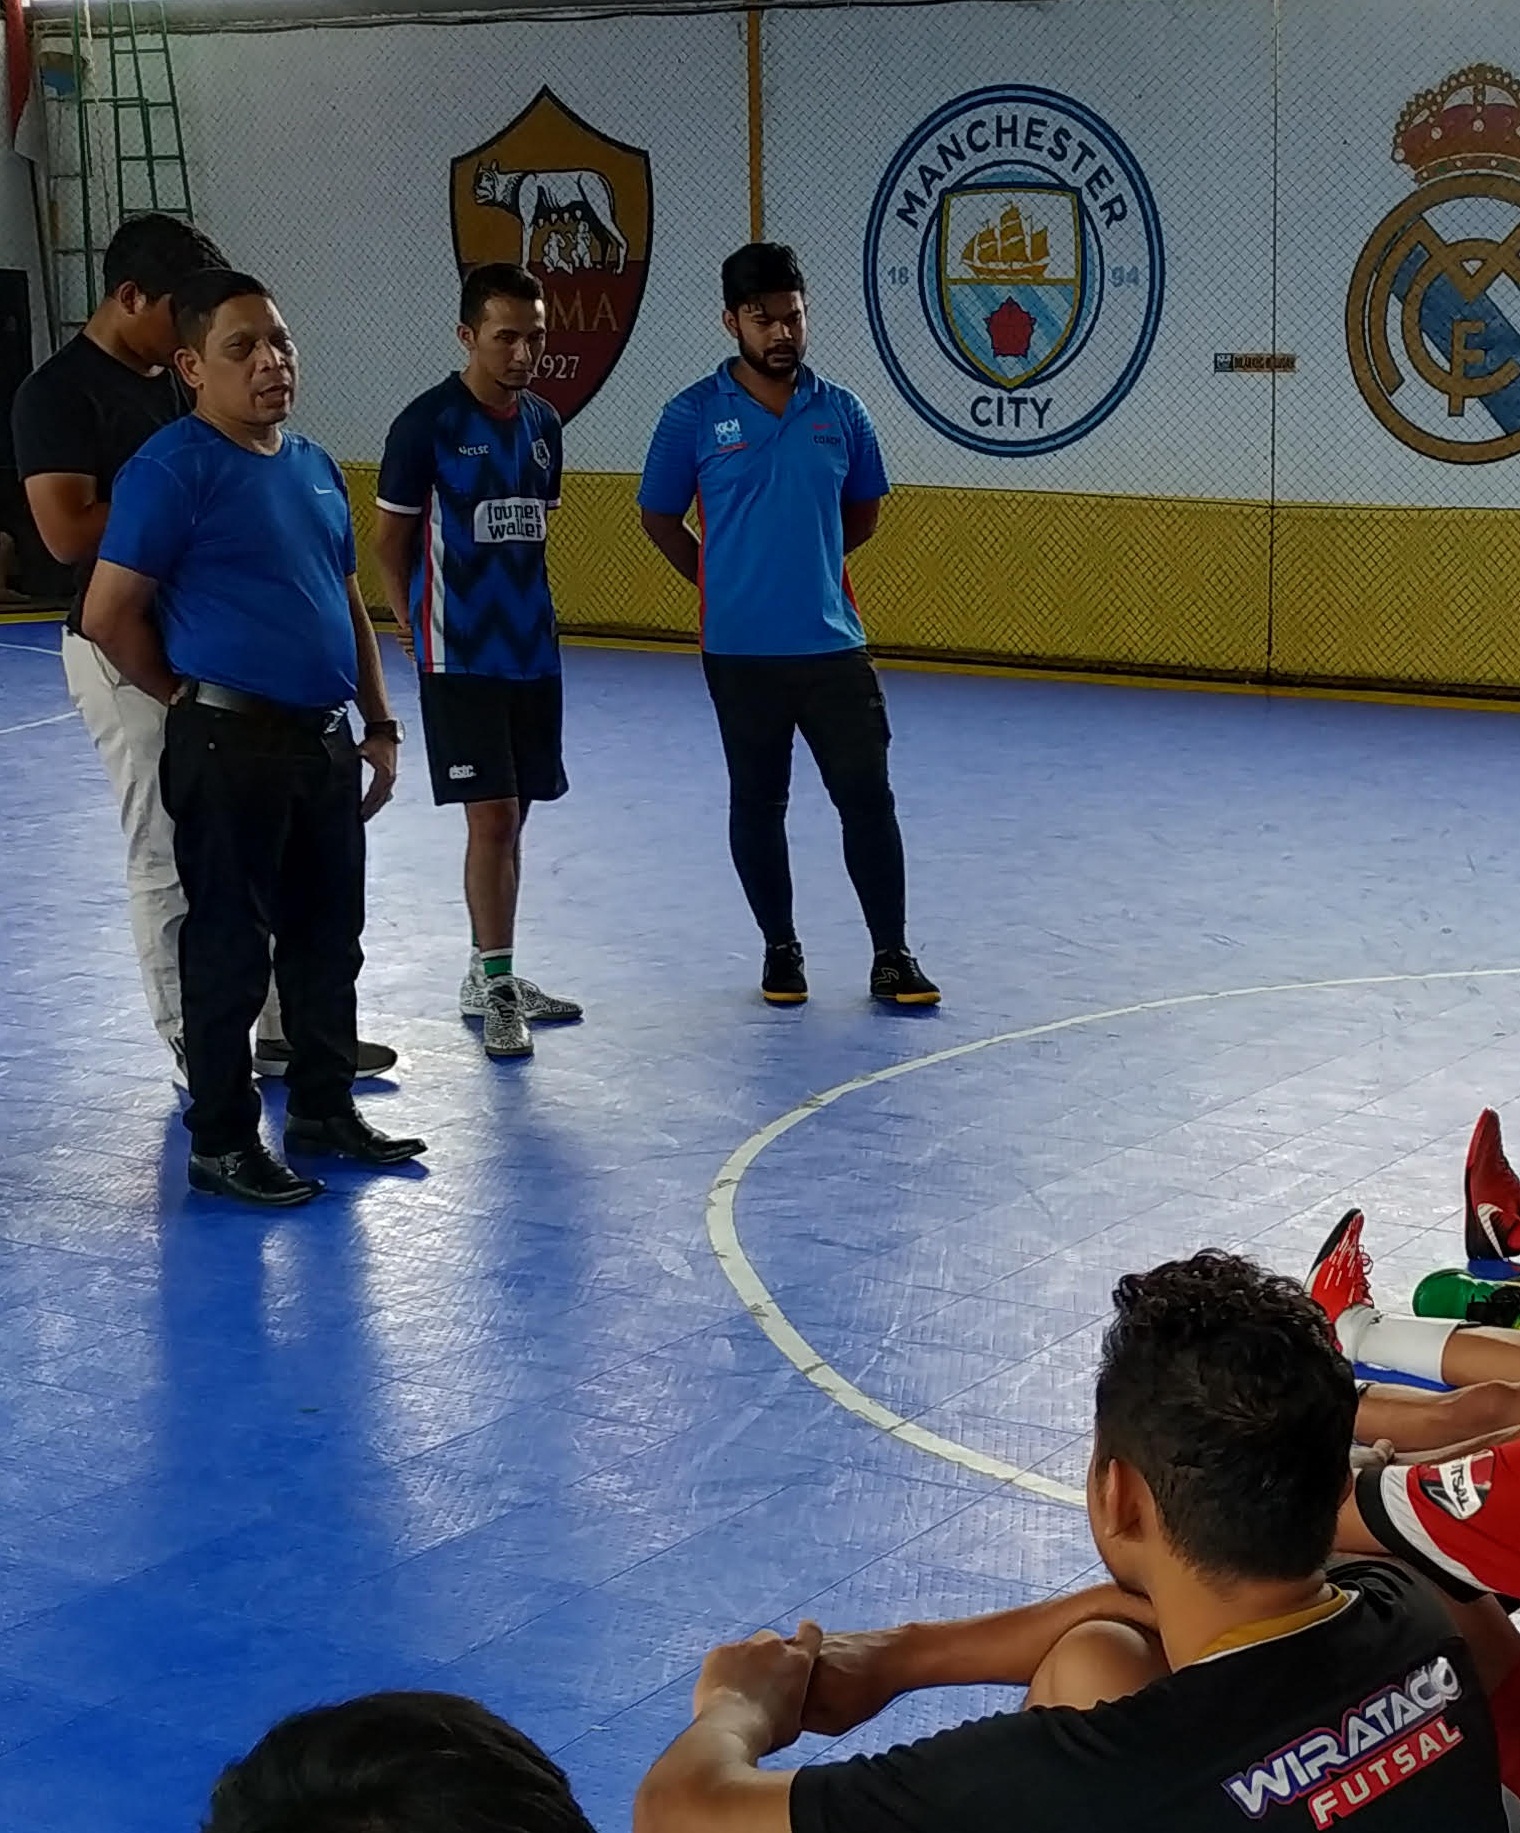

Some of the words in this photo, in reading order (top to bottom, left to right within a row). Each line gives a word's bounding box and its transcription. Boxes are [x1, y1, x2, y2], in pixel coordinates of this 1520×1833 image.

[896, 115, 1128, 230] MANCHESTER
[550, 289, 620, 333] MA
[888, 266, 909, 286] 18
[970, 396, 1053, 429] CITY
[1230, 1656, 1460, 1813] WIRATACO
[1311, 1718, 1461, 1824] FUTSAL
